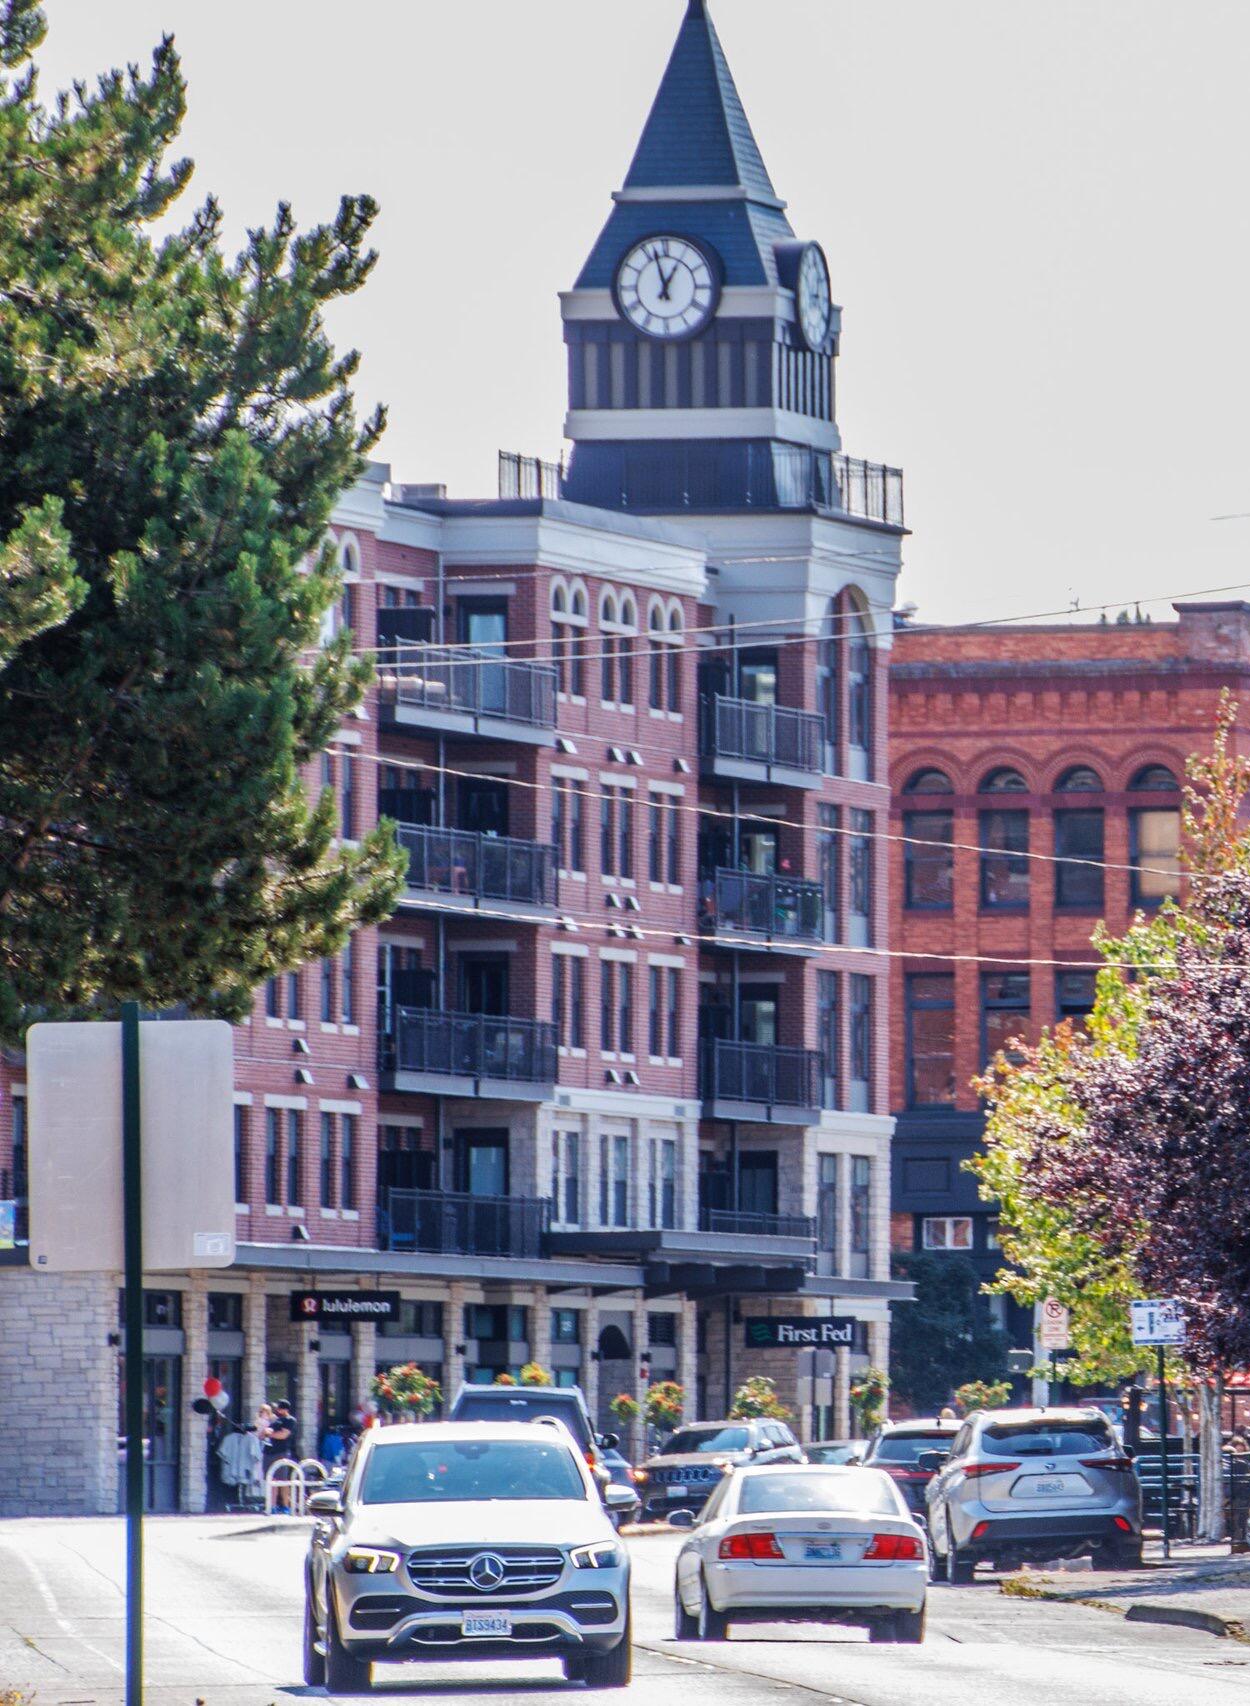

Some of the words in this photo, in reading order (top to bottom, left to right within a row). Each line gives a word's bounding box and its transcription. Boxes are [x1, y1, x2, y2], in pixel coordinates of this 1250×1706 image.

[322, 1298, 392, 1313] lululemon
[777, 1325, 820, 1342] First
[820, 1323, 853, 1342] Fed
